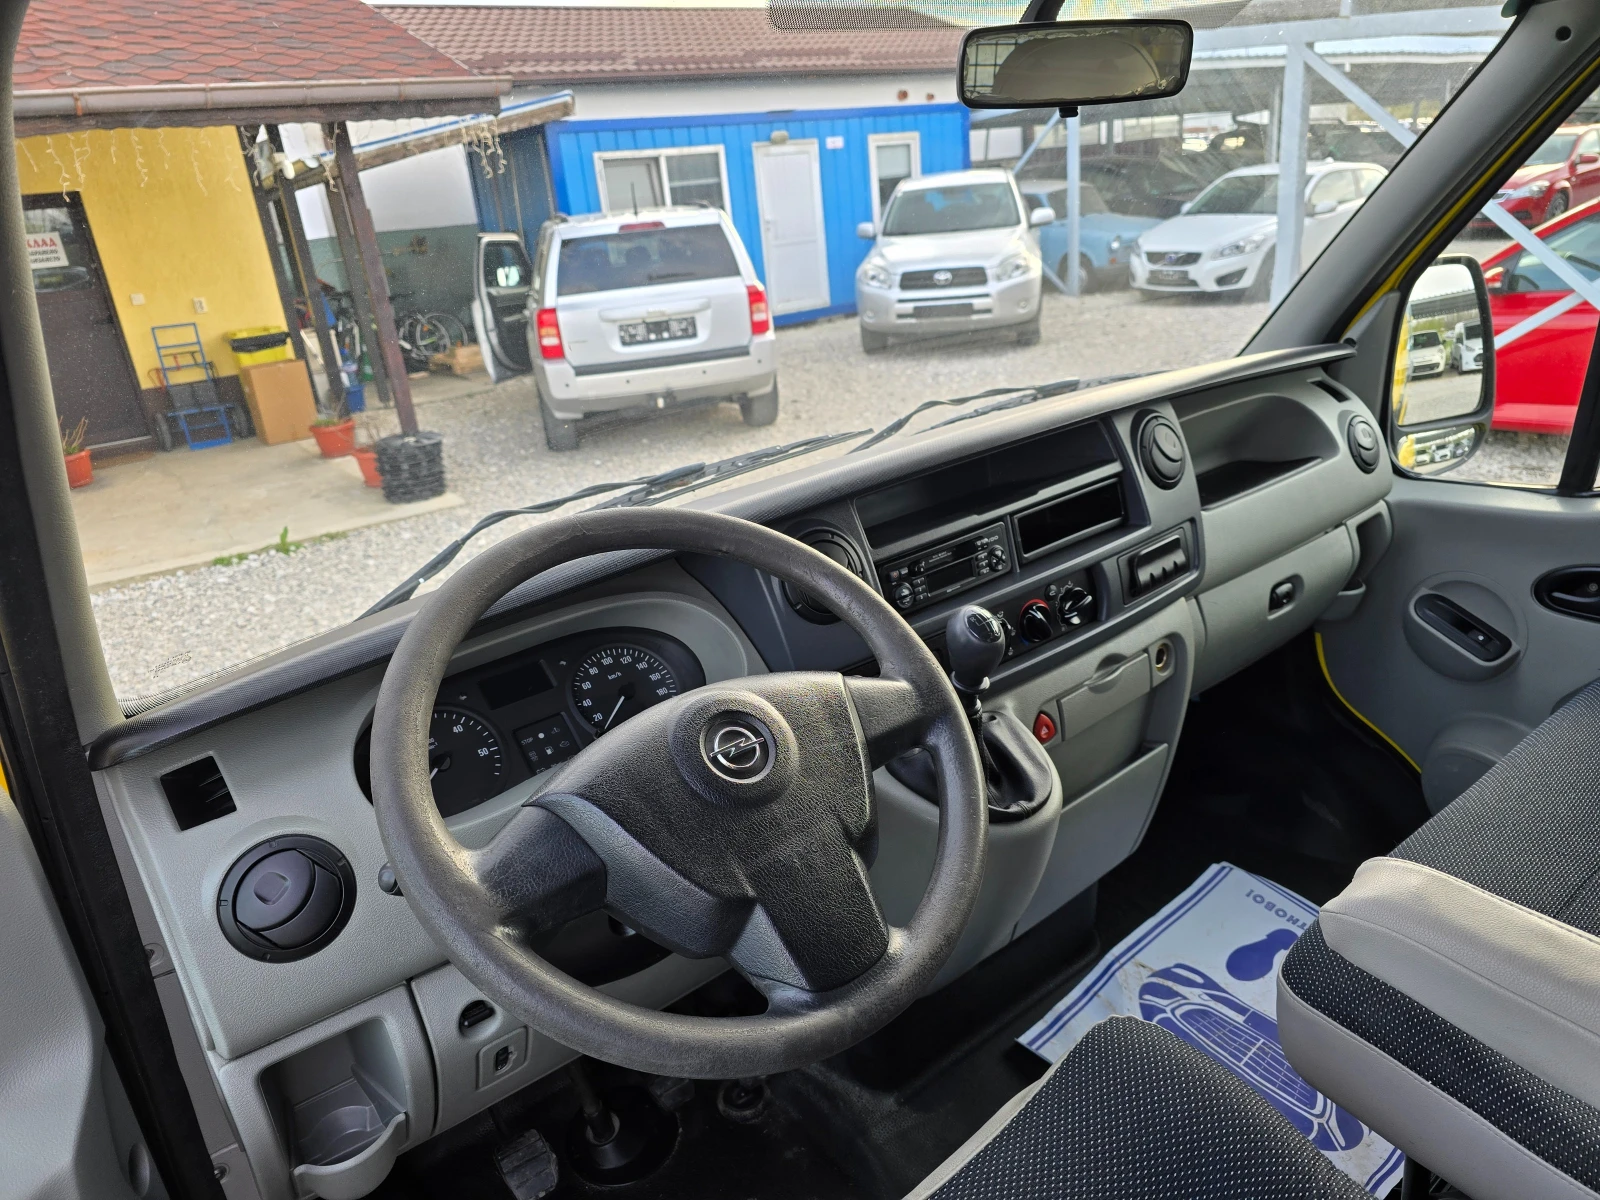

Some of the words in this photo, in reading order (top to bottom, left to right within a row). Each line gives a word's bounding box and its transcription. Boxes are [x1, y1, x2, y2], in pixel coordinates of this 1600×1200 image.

[601, 656, 614, 666] 100
[620, 655, 632, 664] 120
[636, 661, 648, 670] 140
[588, 666, 599, 675] 80
[607, 671, 622, 680] km/h
[649, 672, 661, 682] 160
[581, 681, 592, 690] 60
[656, 687, 668, 696] 180
[582, 698, 592, 707] 40
[593, 712, 603, 722] 20
[452, 724, 464, 734] 40
[477, 747, 489, 757] 50
